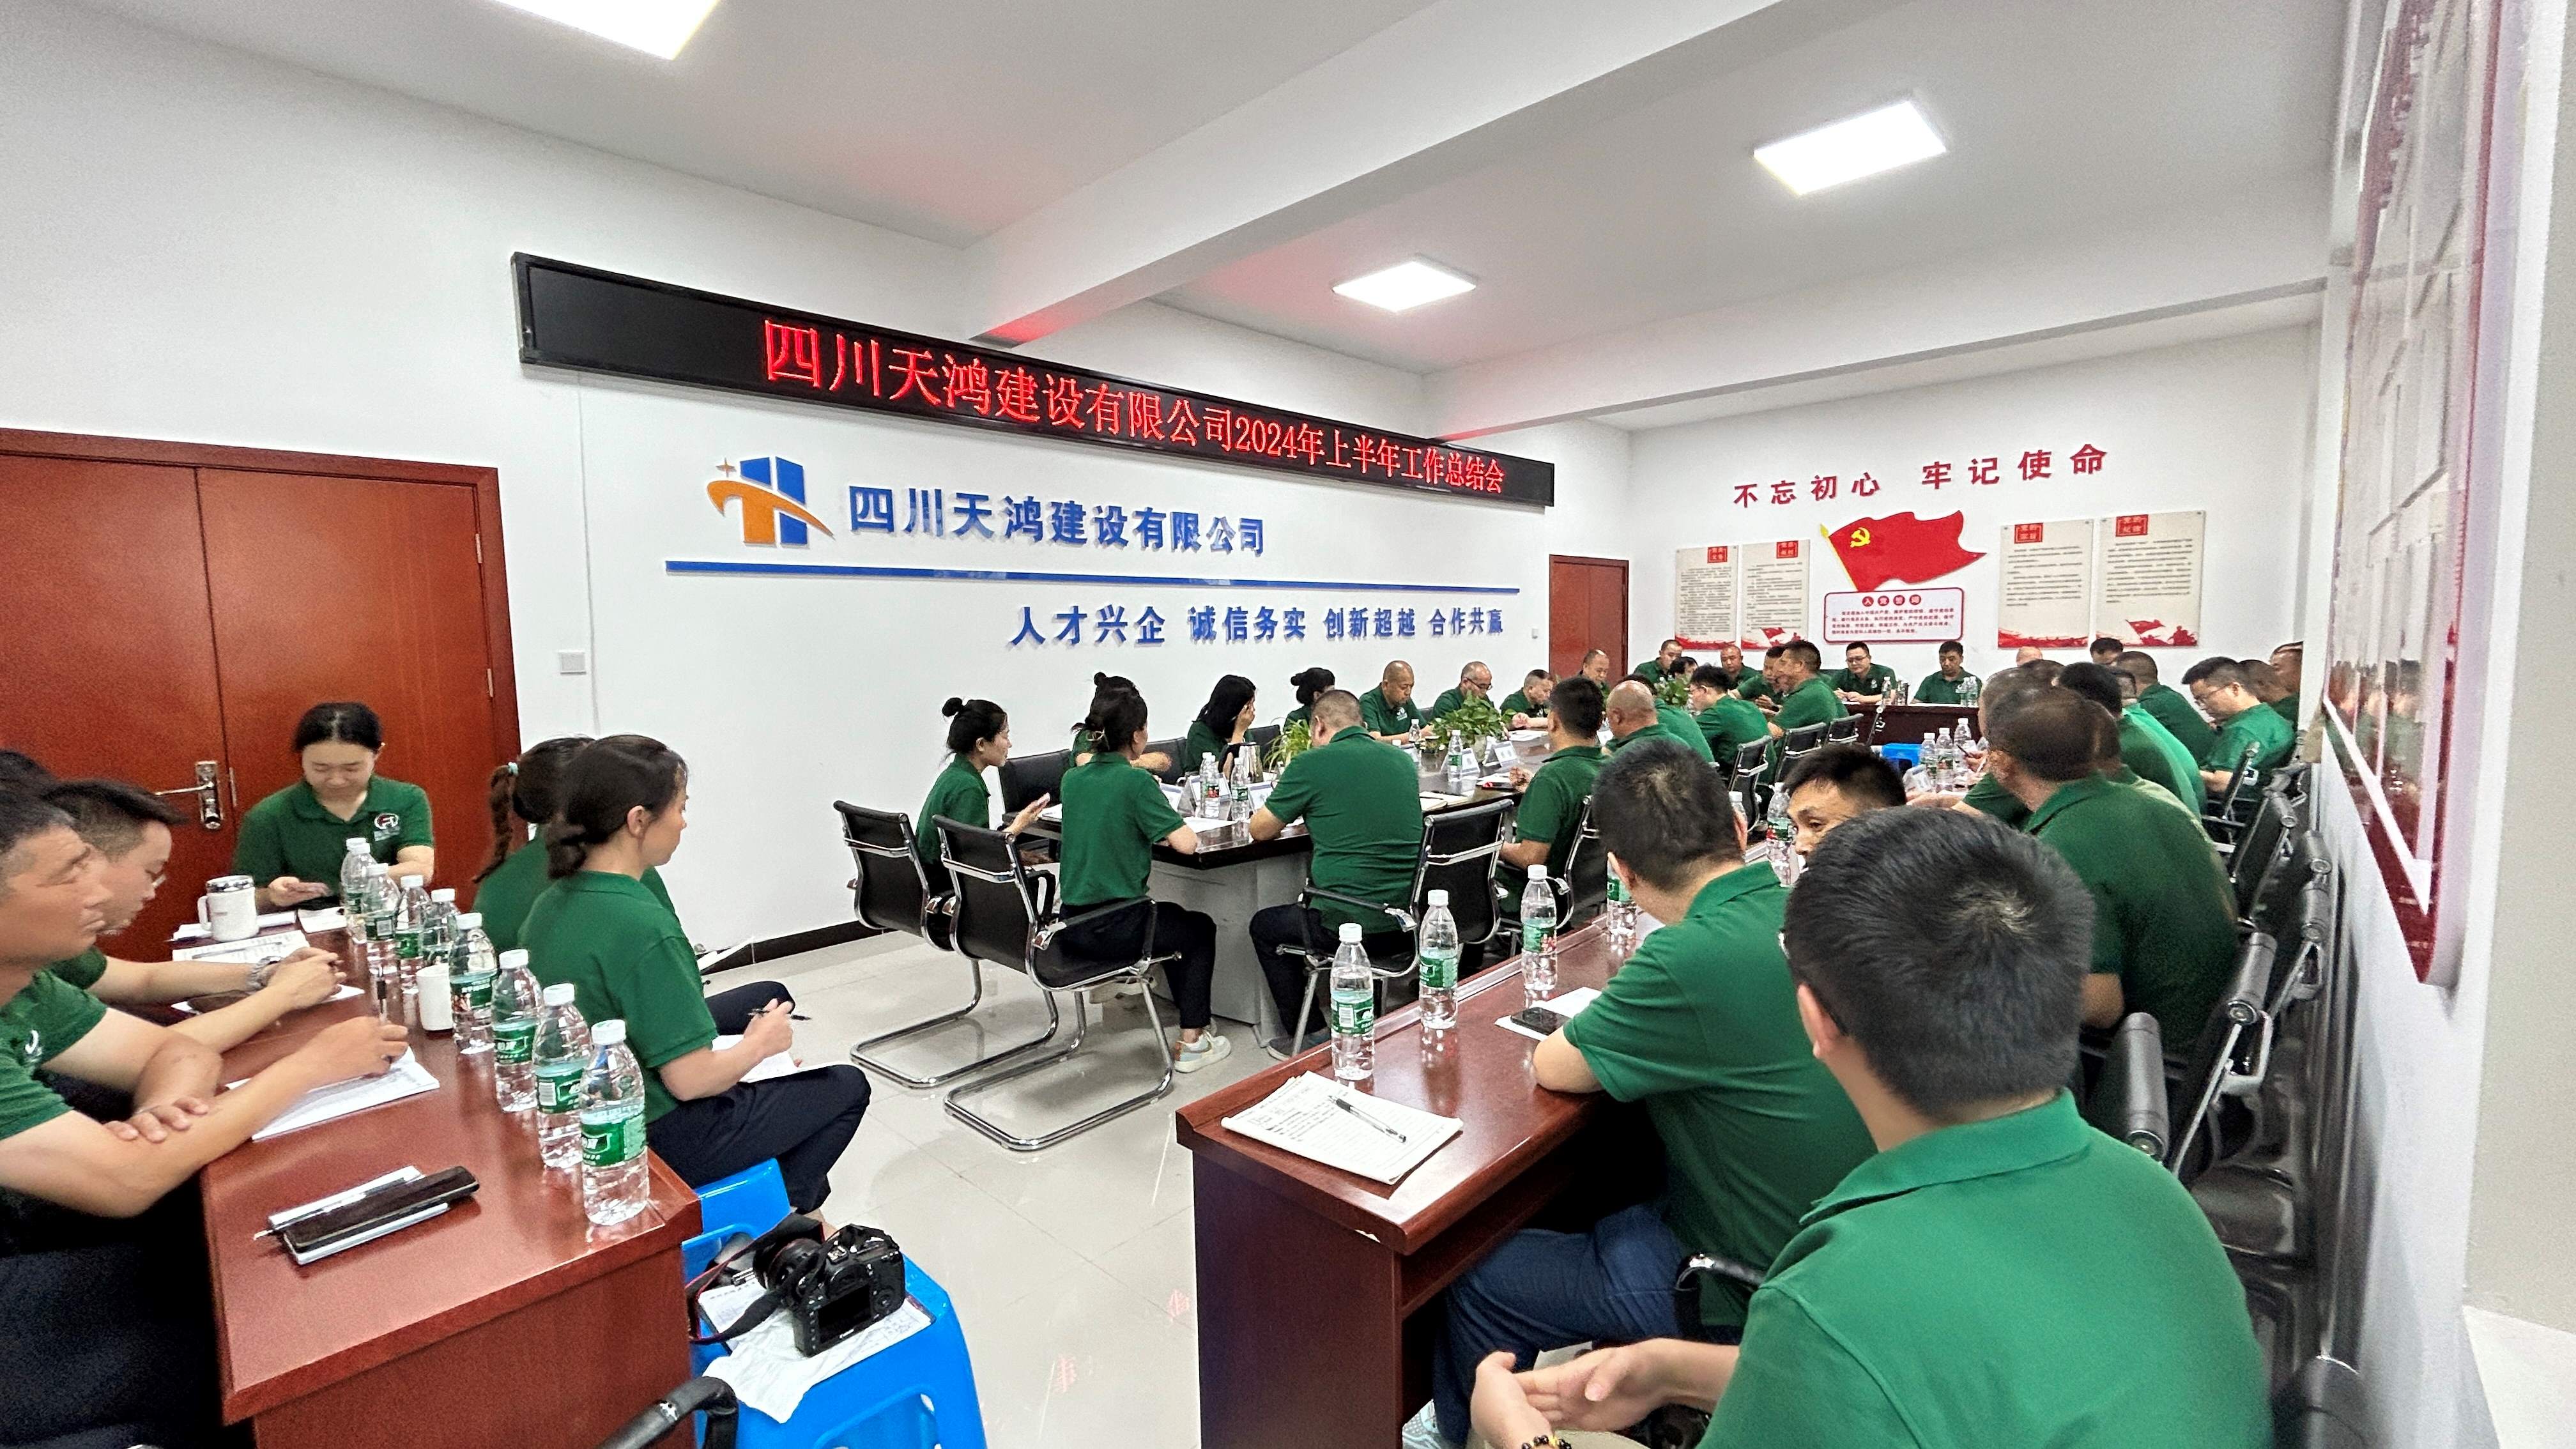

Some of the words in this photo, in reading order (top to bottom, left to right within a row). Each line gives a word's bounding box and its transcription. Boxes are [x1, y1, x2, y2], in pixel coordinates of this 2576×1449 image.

[764, 319, 1505, 494] 四川天鸿建设有限公司2024年上半年工作总结会
[1733, 471, 1880, 509] 不忘初心
[1921, 443, 2107, 490] 牢记使命
[849, 486, 1264, 557] 四川天鸿建设有限公司
[1011, 604, 1165, 646] 人才兴企
[1188, 605, 1306, 640] 诚信务实
[1324, 607, 1416, 638] 创新超越
[1429, 607, 1503, 636] 合作共赢
